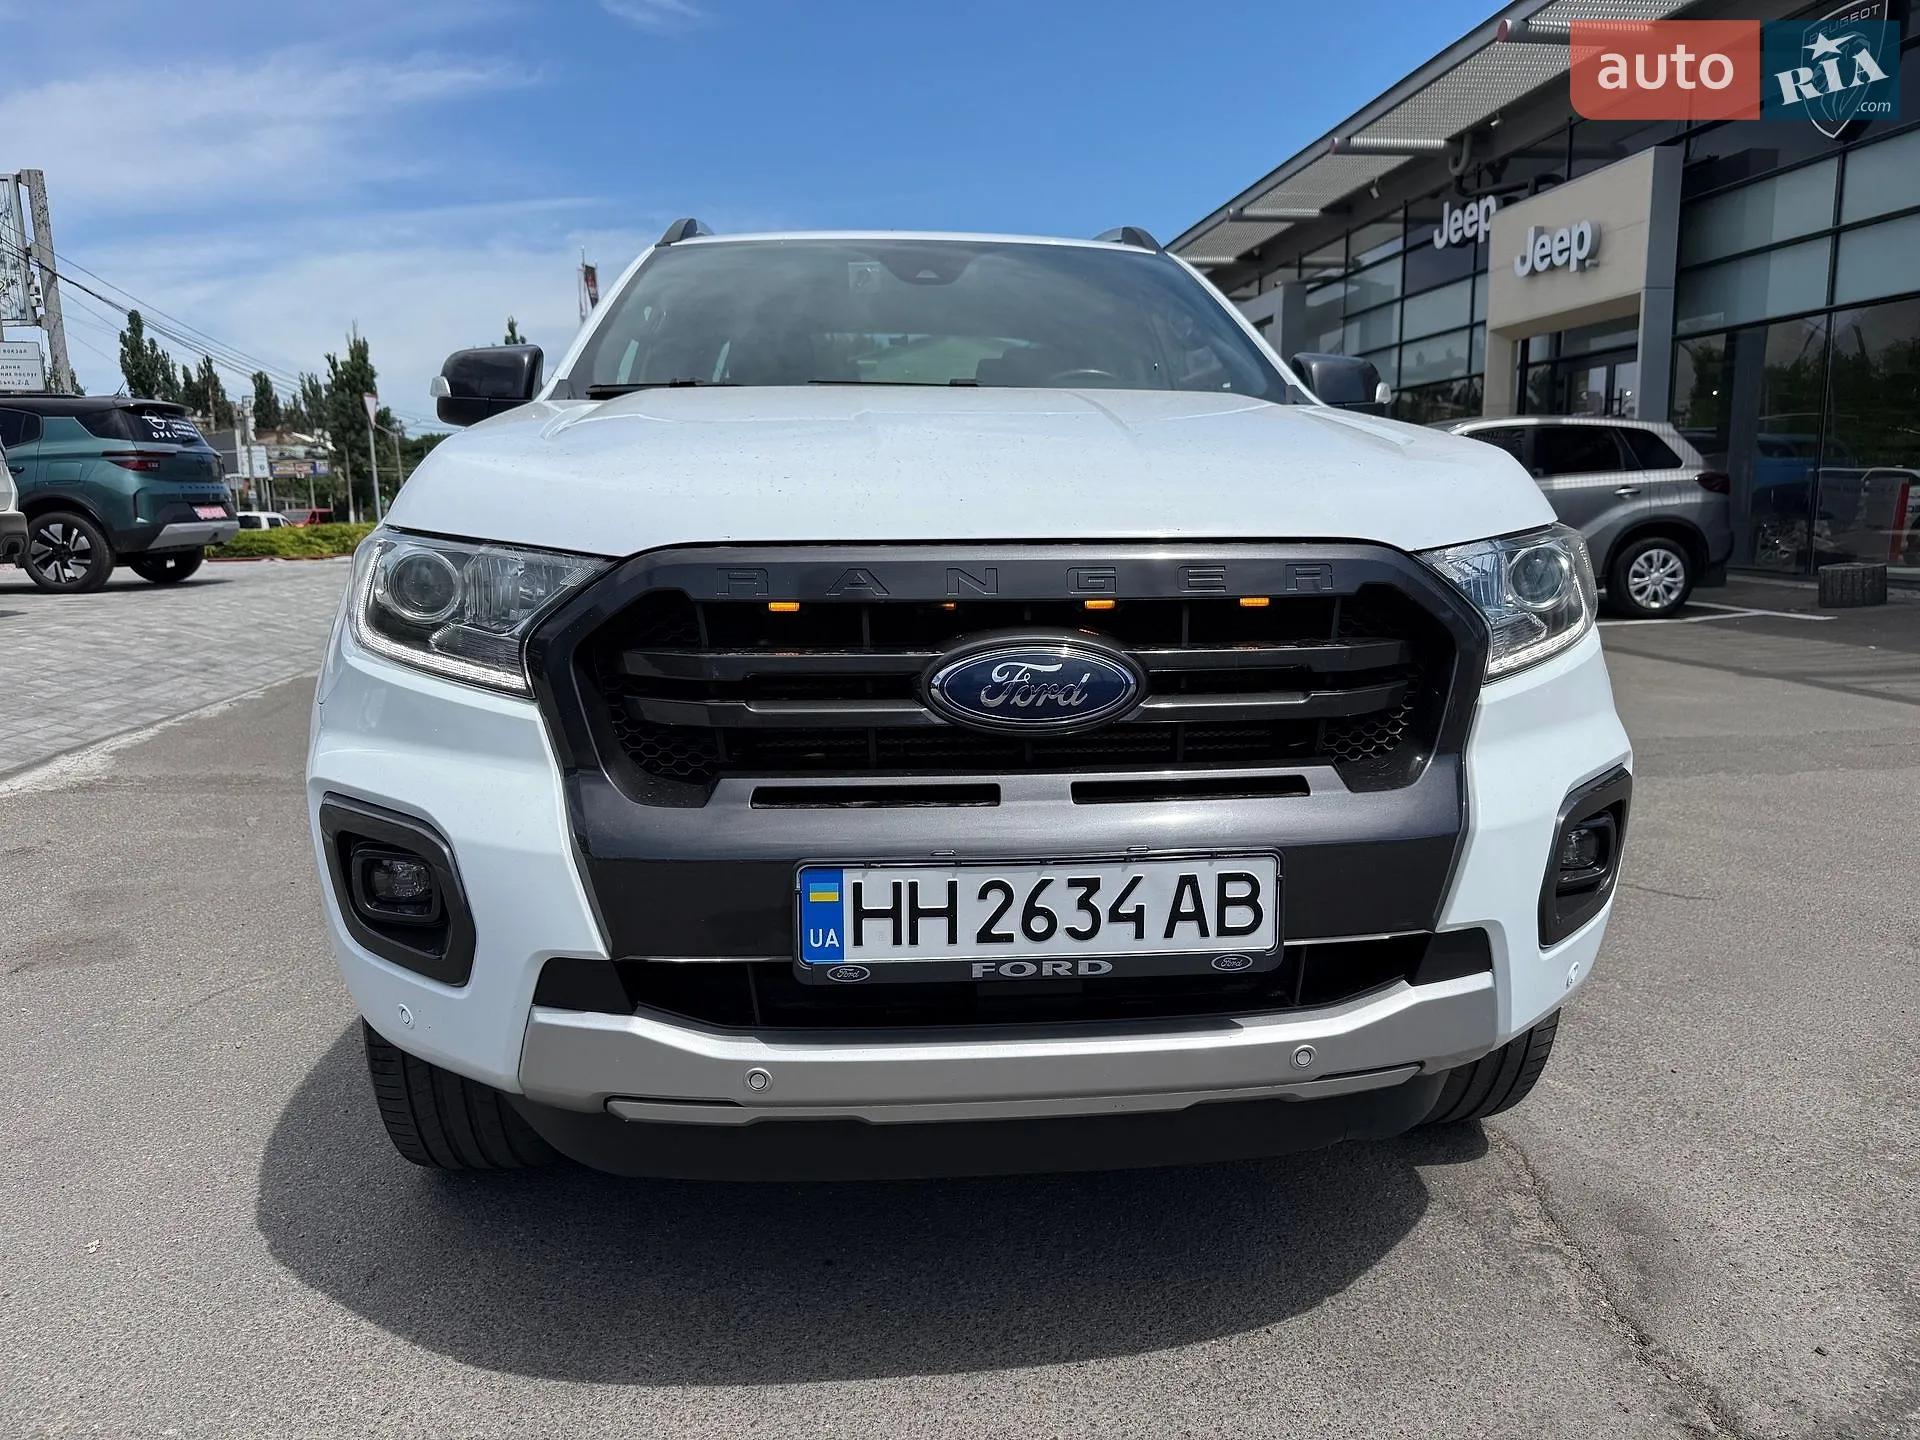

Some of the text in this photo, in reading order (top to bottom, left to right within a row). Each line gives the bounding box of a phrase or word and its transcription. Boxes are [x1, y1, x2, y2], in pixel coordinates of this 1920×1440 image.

[1809, 3, 1881, 44] PEUGEOT
[1433, 195, 1496, 250] Jeep
[1514, 219, 1593, 278] Jeep
[152, 431, 178, 439] OPEL
[716, 563, 1333, 596] RANGER
[980, 661, 1091, 708] Ford
[852, 871, 1264, 947] HH 2634 AB
[809, 928, 840, 948] UA
[836, 967, 861, 979] Ford
[971, 959, 1113, 979] FORD
[1219, 956, 1244, 968] Ford
